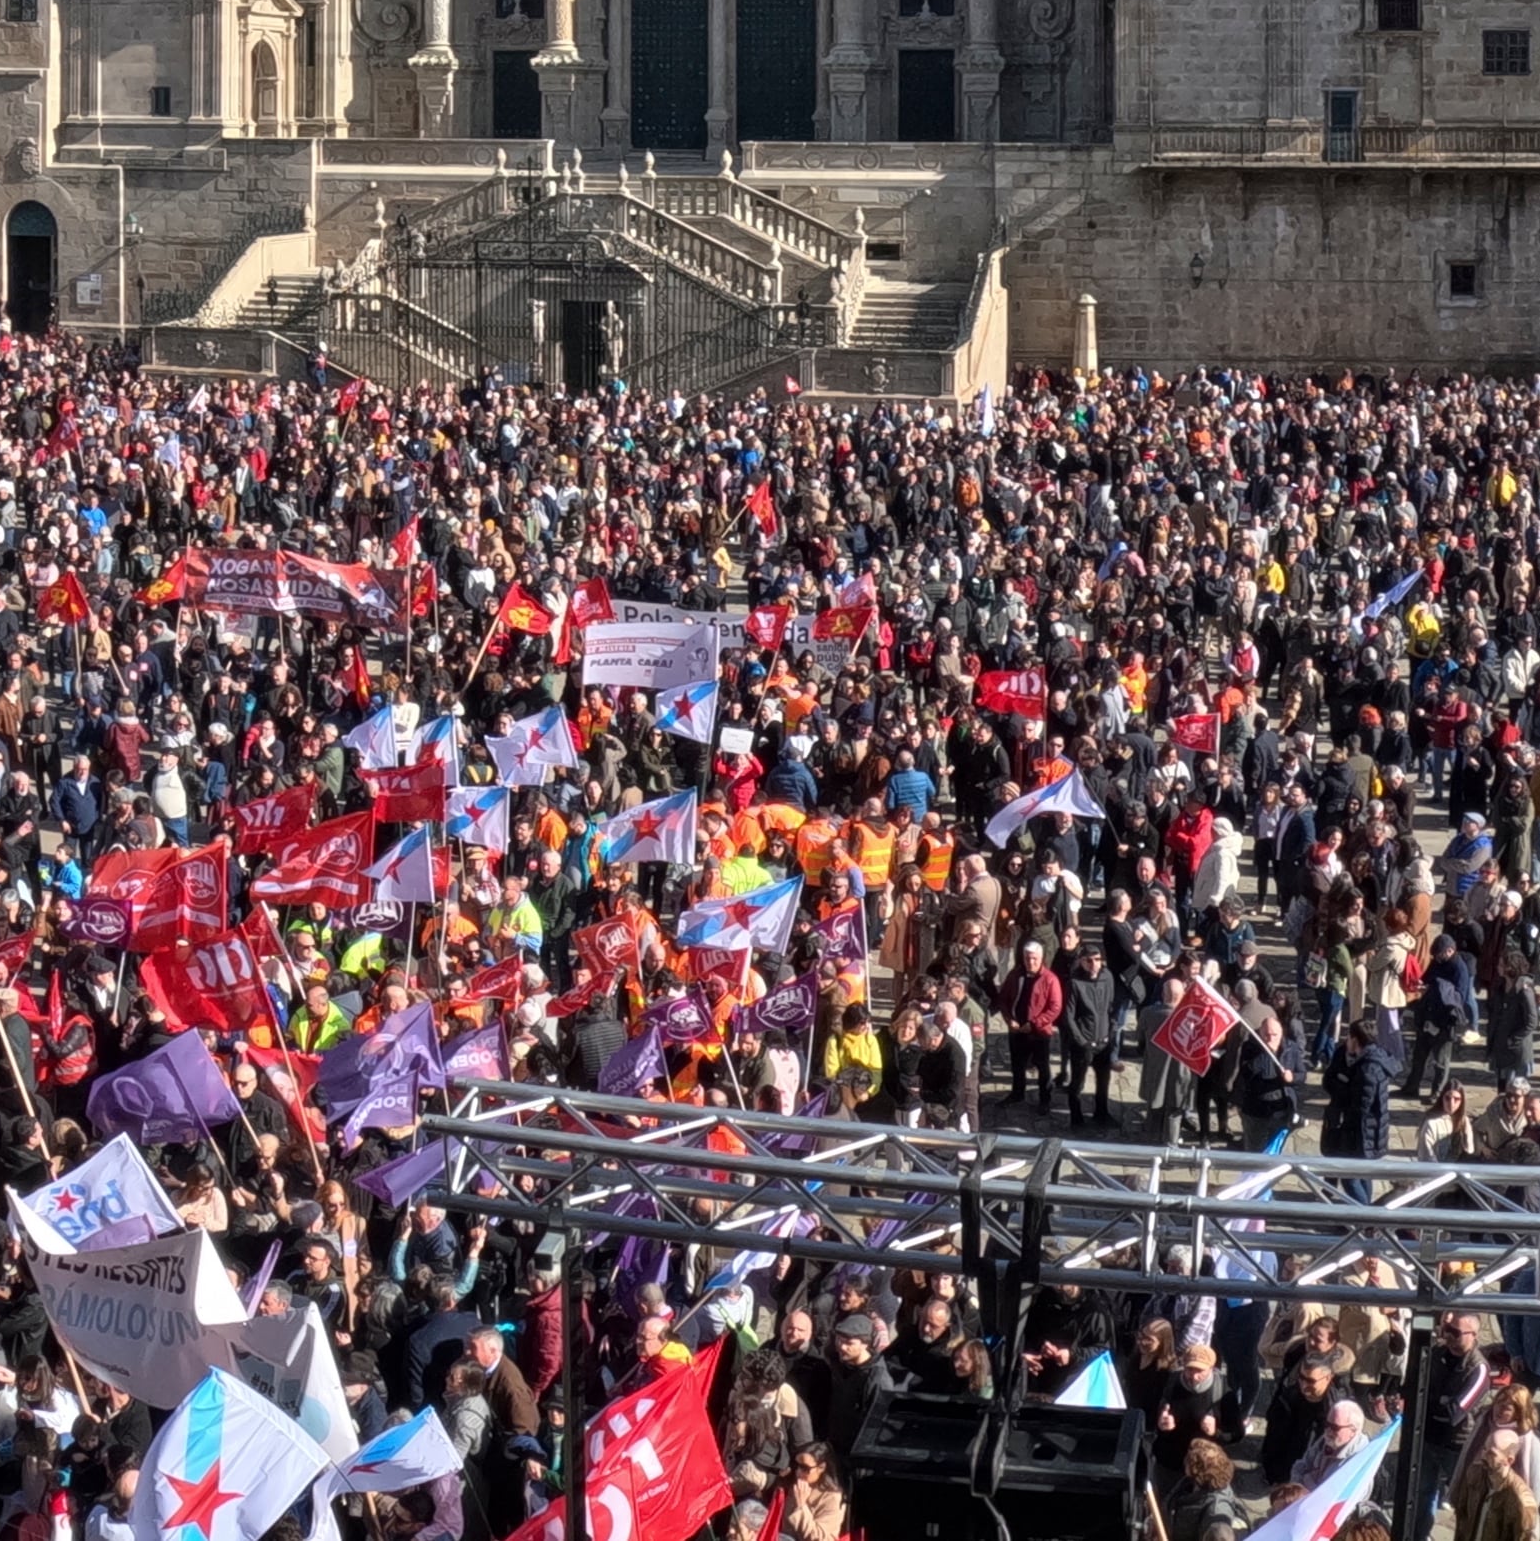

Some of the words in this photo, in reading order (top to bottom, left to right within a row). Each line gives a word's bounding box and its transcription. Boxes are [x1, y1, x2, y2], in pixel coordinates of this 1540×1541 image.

[210, 558, 276, 576] XOGAN
[207, 578, 273, 597] NOSAS
[277, 580, 340, 600] VIDAS
